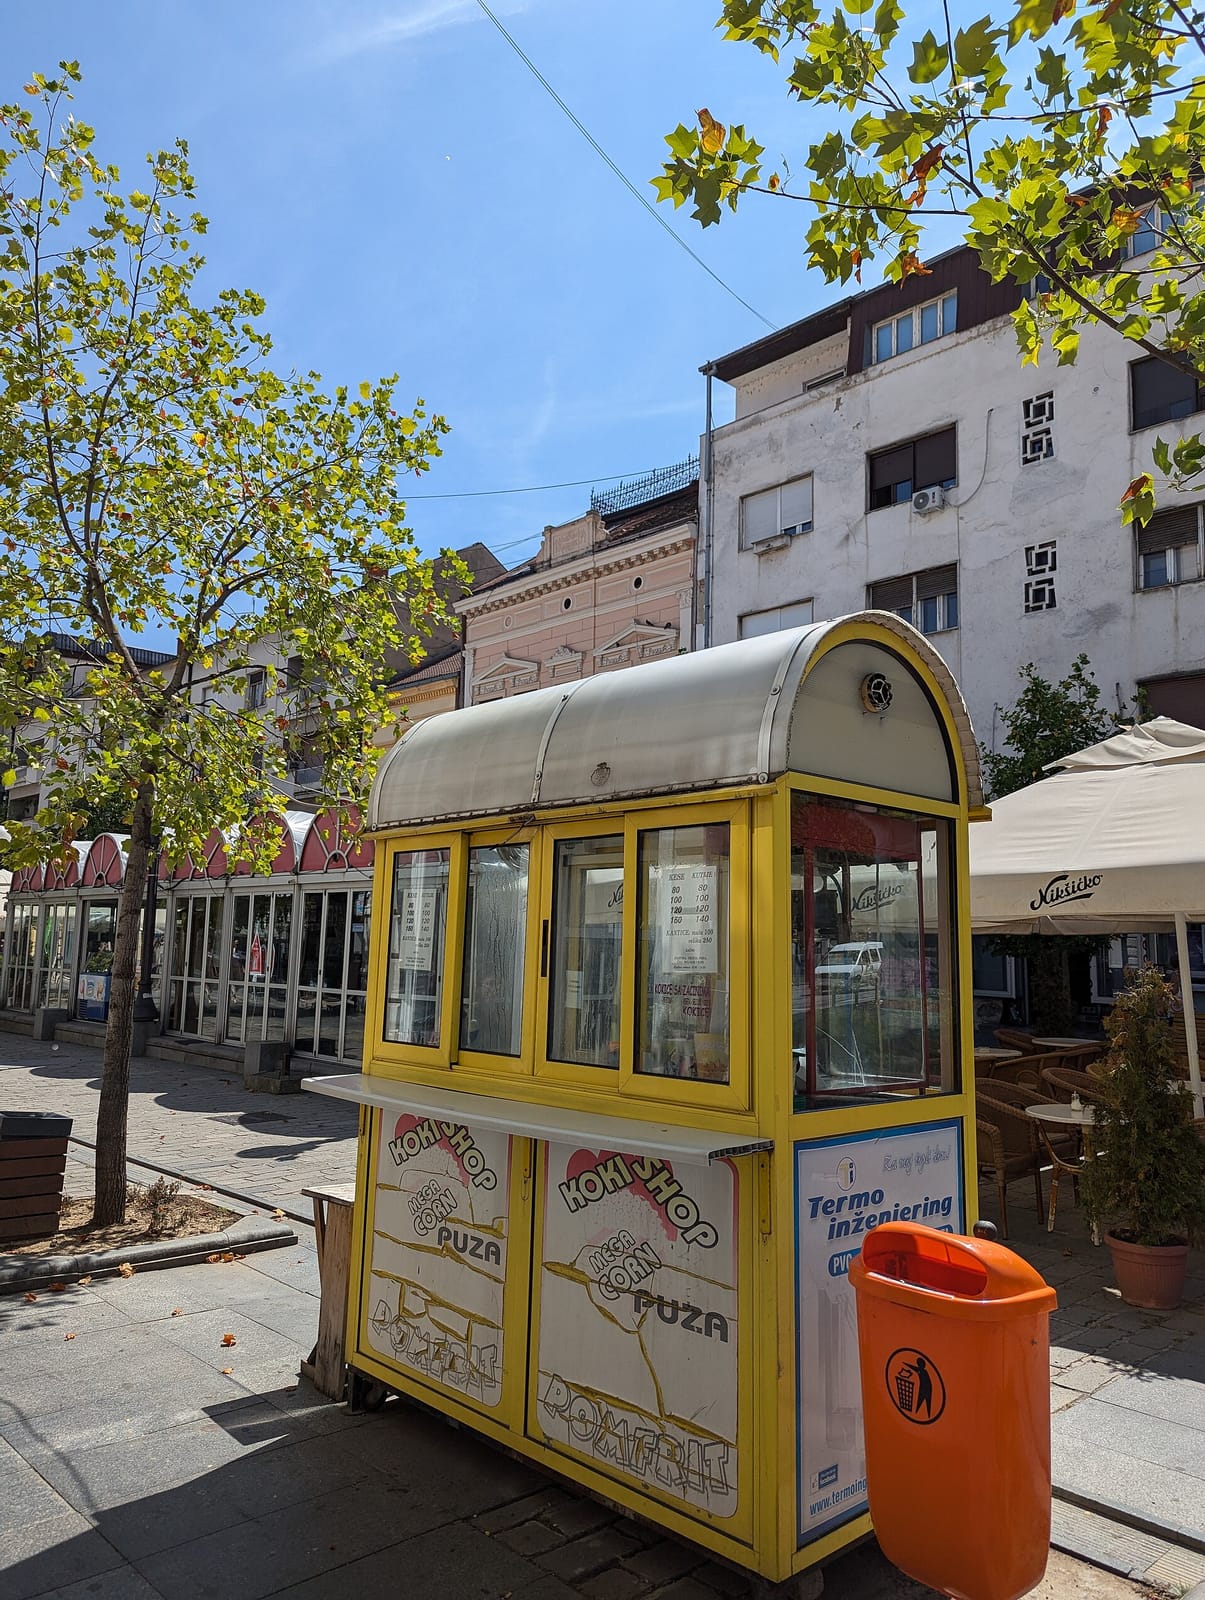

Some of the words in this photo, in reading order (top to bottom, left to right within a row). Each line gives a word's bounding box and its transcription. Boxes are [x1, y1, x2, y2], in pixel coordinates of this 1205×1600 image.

[670, 895, 682, 904] 100
[695, 894, 709, 902] 100
[671, 886, 681, 894] 80
[697, 884, 708, 892] 80
[1031, 874, 1103, 911] Nikšićko
[670, 906, 682, 914] 120
[695, 904, 709, 912] 120
[695, 915, 709, 923] 140
[388, 1119, 443, 1167] KOKI
[440, 1122, 498, 1191] SHOP
[407, 1178, 442, 1216] MEGA
[413, 1188, 458, 1237] CORN
[558, 1154, 635, 1214] KOKI
[631, 1156, 720, 1250] SHOP
[807, 1188, 885, 1220] Termo
[437, 1226, 501, 1266] PUZA
[588, 1229, 636, 1274] MEGA
[598, 1241, 662, 1301] CORN
[633, 1288, 729, 1344] PUZA
[542, 1373, 730, 1496] POMFRIT
[810, 1477, 867, 1516] www.termoing
